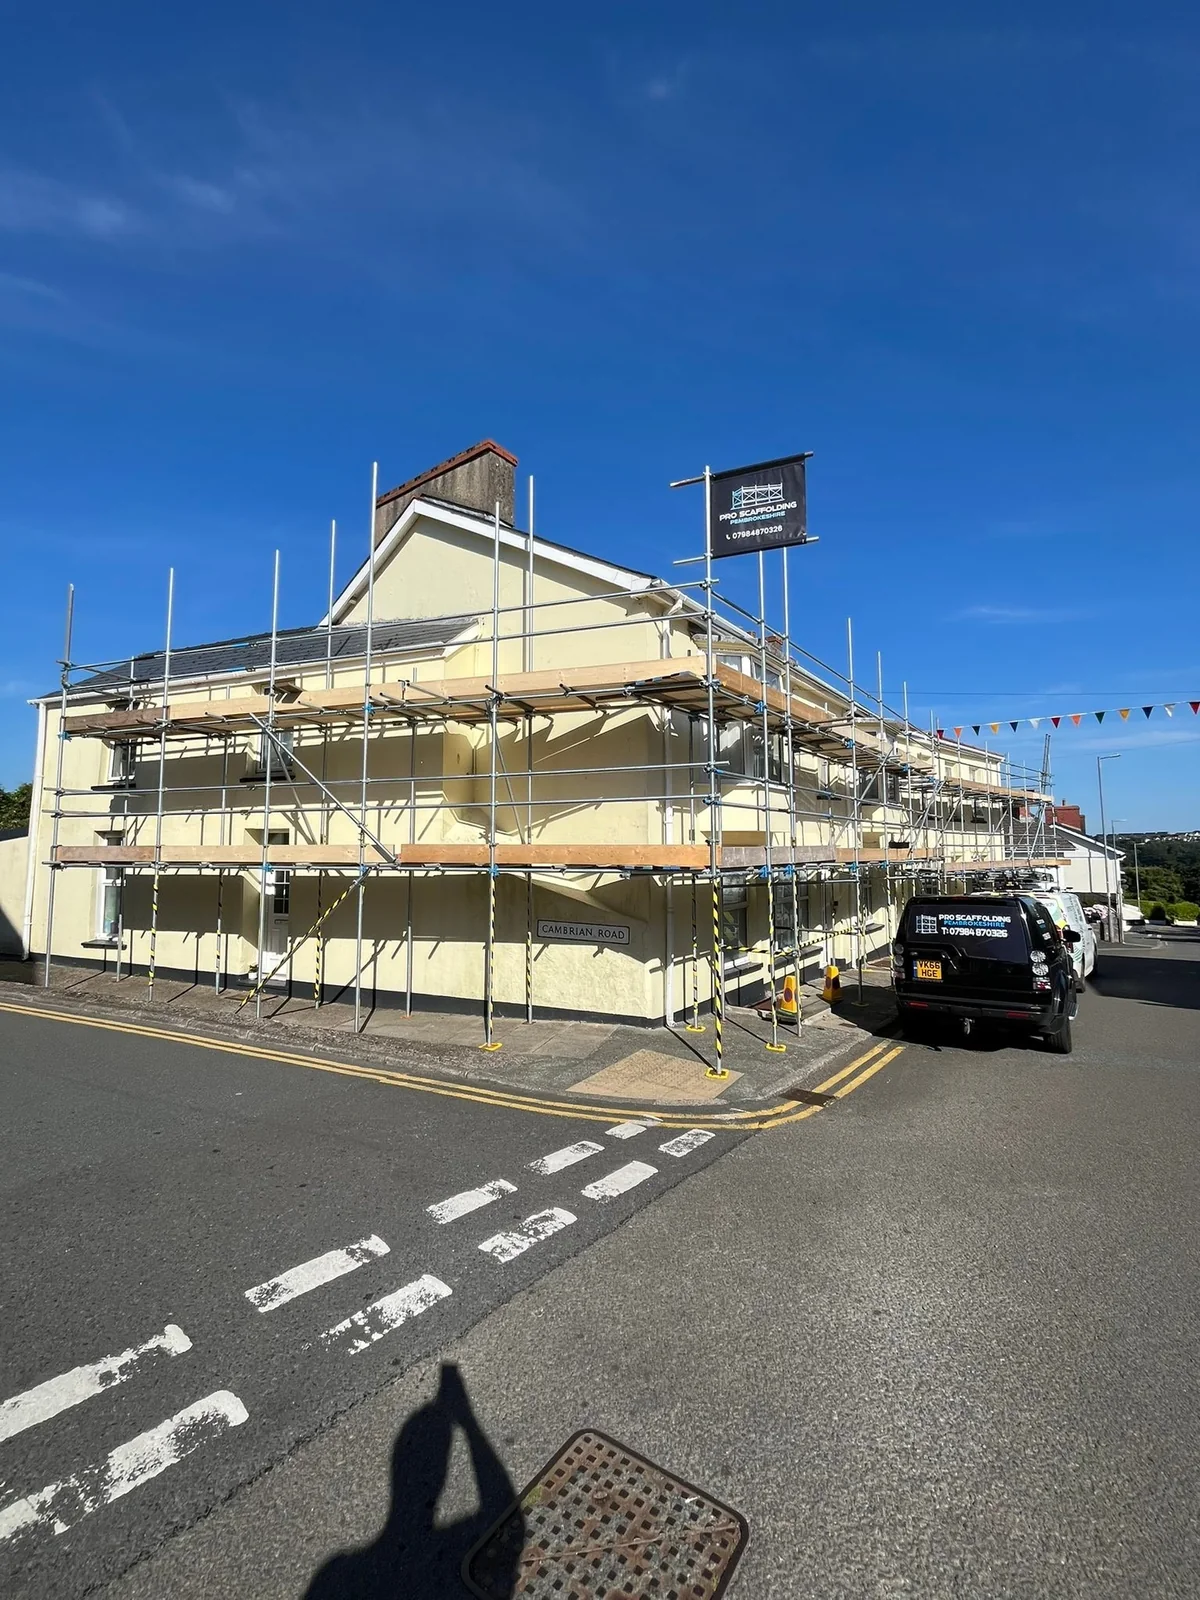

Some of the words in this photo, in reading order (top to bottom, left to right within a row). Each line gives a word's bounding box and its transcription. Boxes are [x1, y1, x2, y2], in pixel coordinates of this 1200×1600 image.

[720, 512, 737, 521] PRO
[740, 501, 797, 517] SCAFFOLDING
[730, 511, 786, 524] PEMBROKESHIRE
[956, 914, 1011, 922] SCAFFOLDING
[542, 924, 592, 936] CAMBRIAN
[598, 930, 624, 939] ROAD
